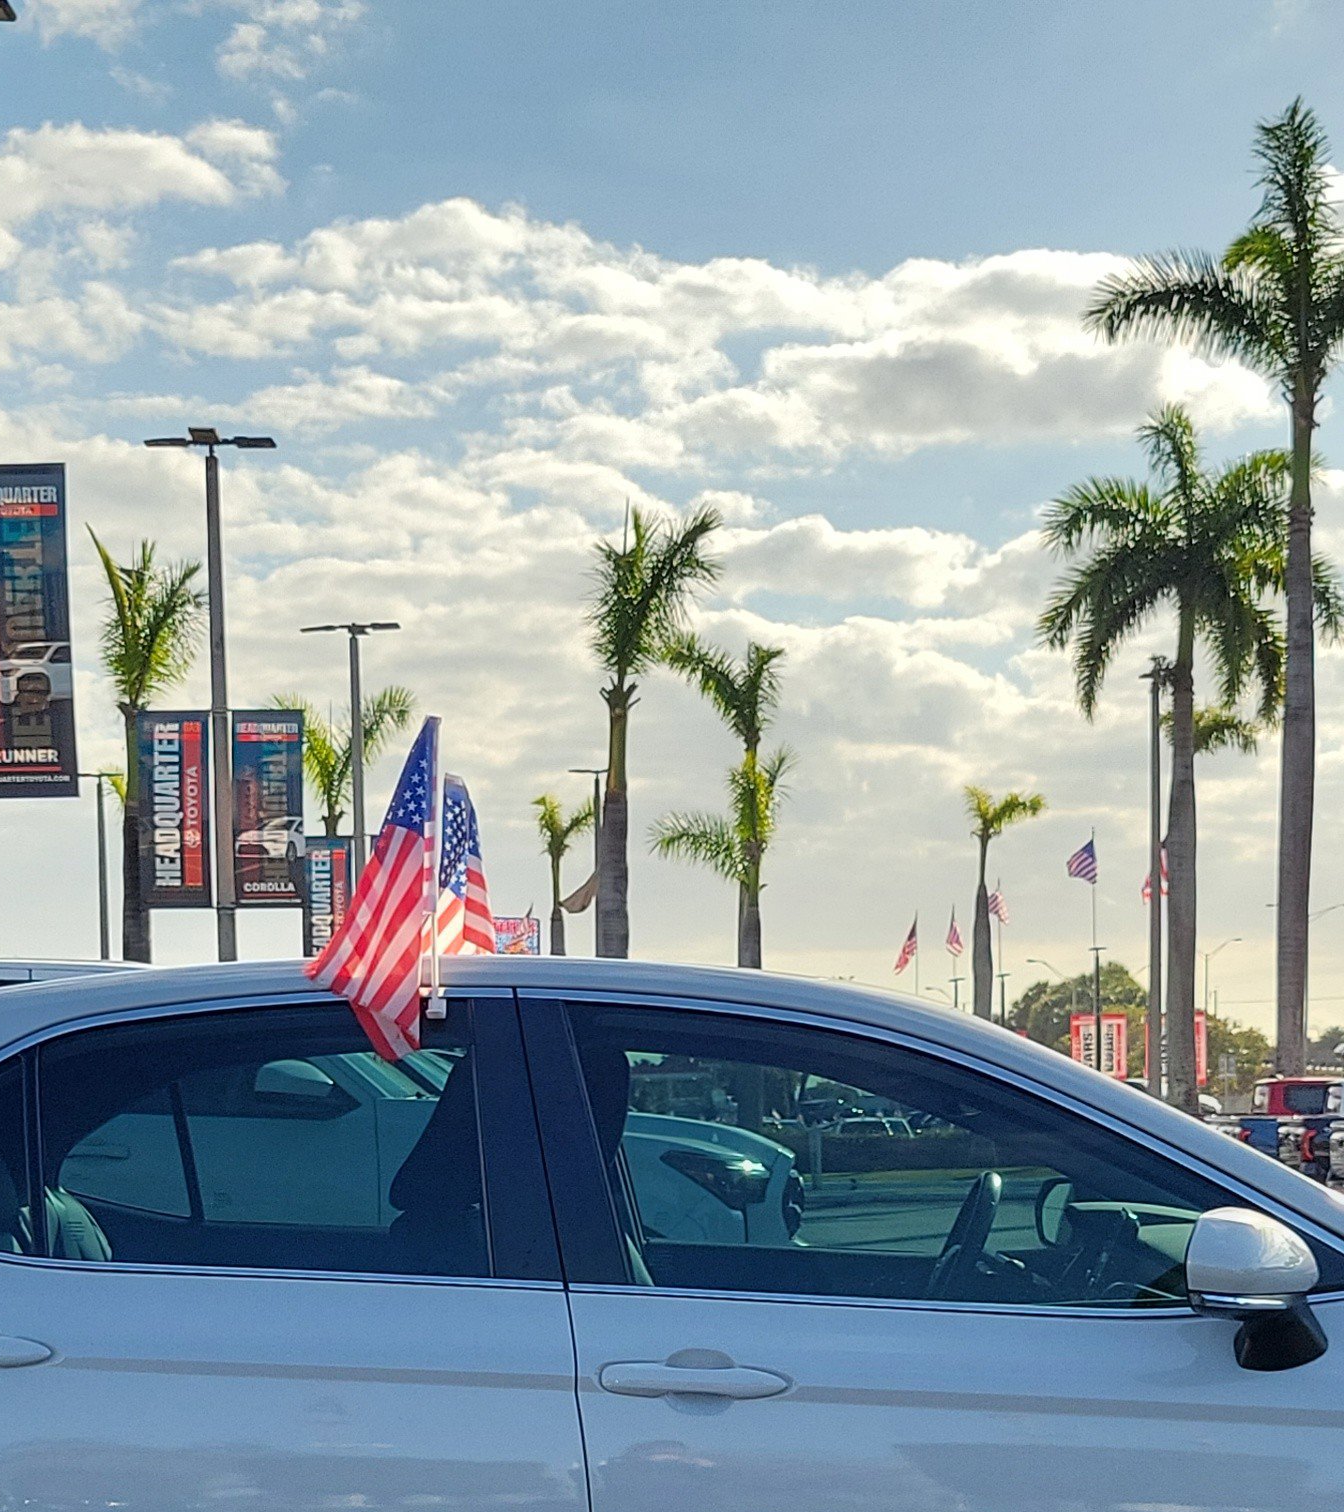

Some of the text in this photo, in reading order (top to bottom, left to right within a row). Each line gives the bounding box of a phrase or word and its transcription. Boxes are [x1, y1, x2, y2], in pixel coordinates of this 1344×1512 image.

[153, 722, 183, 887] HEADQUARTER
[186, 766, 199, 826] TOYOTA
[243, 882, 296, 892] COROLLA
[311, 849, 333, 955] EADQUARTER
